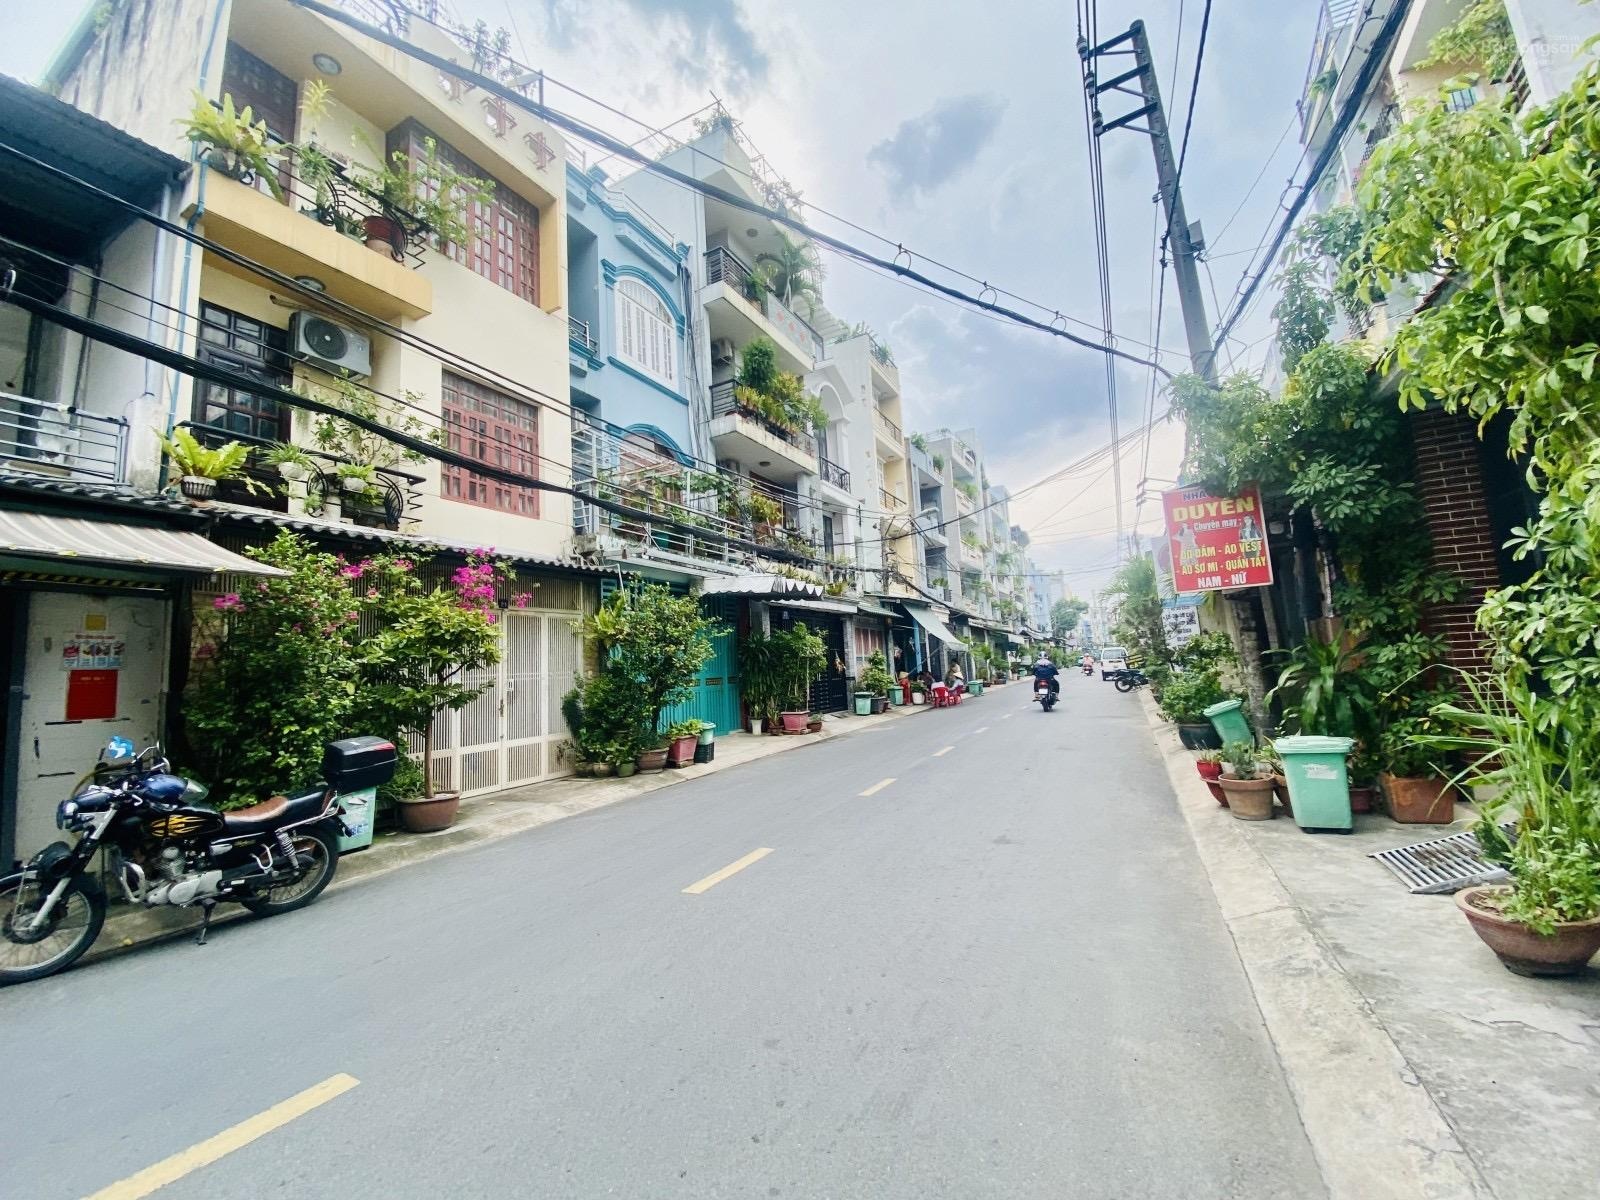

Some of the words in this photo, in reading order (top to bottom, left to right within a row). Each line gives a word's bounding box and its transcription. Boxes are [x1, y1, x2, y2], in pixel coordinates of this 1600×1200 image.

[1173, 496, 1254, 522] DUYÊN
[1238, 540, 1262, 553] VEST
[1197, 575, 1222, 588] NAM
[1231, 571, 1248, 585] NỮ
